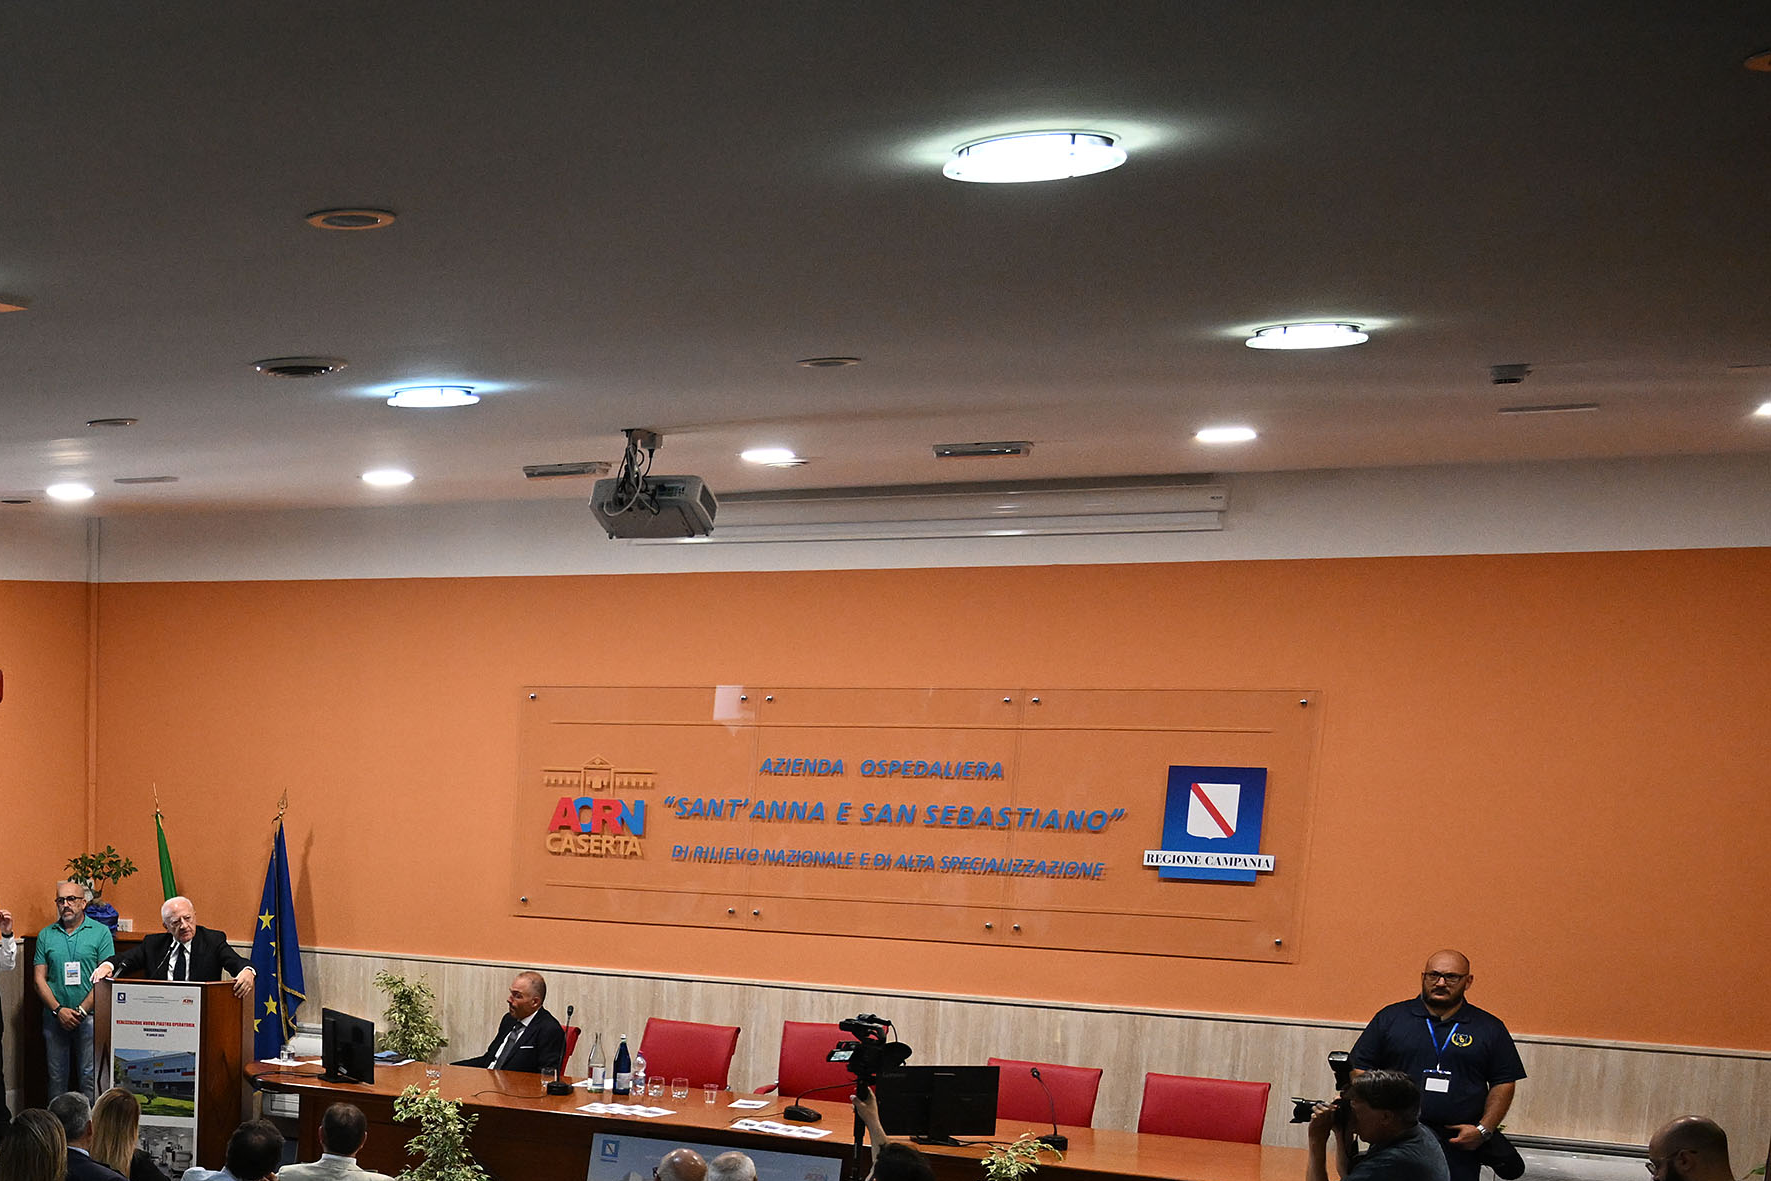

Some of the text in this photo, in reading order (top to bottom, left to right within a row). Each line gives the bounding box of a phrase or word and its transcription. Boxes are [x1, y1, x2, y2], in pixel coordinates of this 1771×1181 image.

[759, 758, 1003, 778] AZIENDA OSPEDALIERA
[548, 797, 645, 835] AORN
[836, 802, 852, 822] E
[859, 803, 917, 824] SAN
[923, 804, 1126, 832] SEBASTIANO”
[546, 832, 643, 857] CASERTA
[671, 845, 1106, 877] DI RILIEVO NAZIONALE E DI ALTA SPECIALIZZAZIONE
[1146, 853, 1271, 868] REGIONE CAMPANIA
